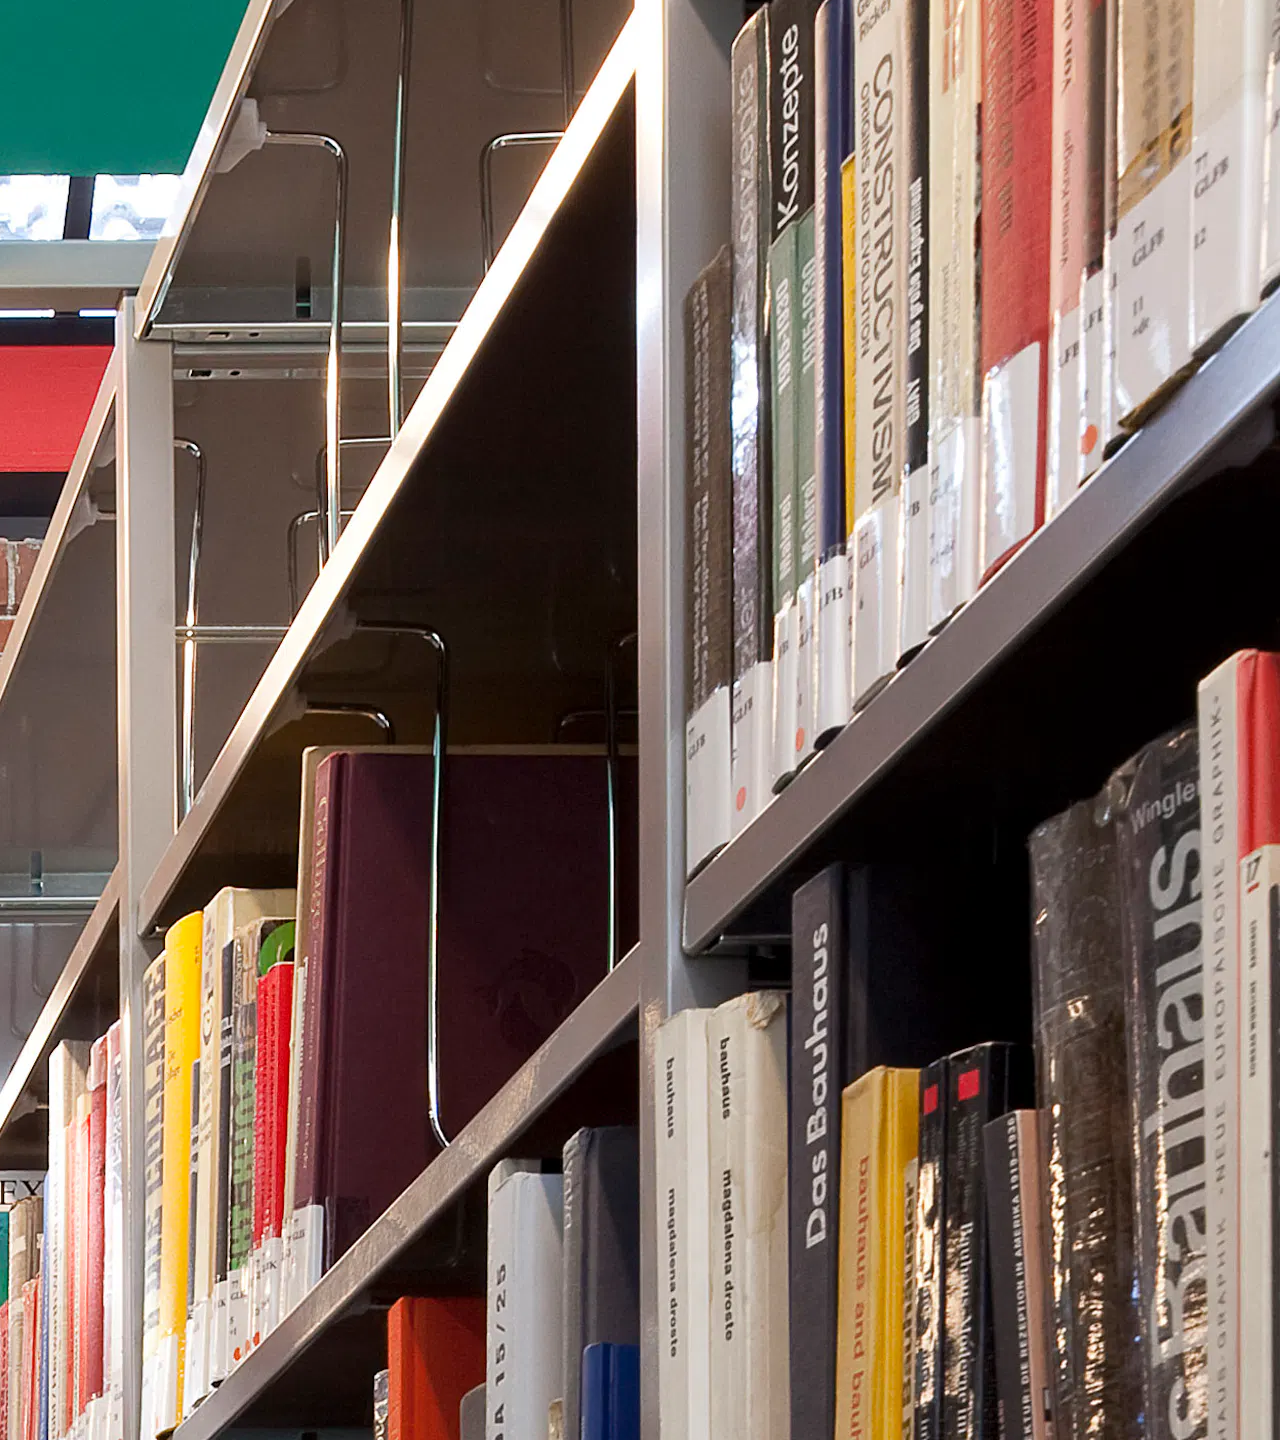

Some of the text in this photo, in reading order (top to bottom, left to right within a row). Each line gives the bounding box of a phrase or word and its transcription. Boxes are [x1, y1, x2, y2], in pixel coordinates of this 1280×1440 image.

[777, 21, 803, 232] Konzepte
[1060, 39, 1078, 90] Von
[858, 82, 873, 359] ORIGINS AND EVOLUTION
[871, 53, 893, 506] CONSTRUCTIVISM
[719, 1037, 735, 1342] bauhaus magdalena droste
[804, 922, 829, 1249] Das Bauhaus
[494, 1262, 507, 1386] 15/25
[665, 1058, 679, 1358] bauhaus magdalena droste
[854, 1153, 871, 1291] bauhaus
[852, 1302, 867, 1360] and
